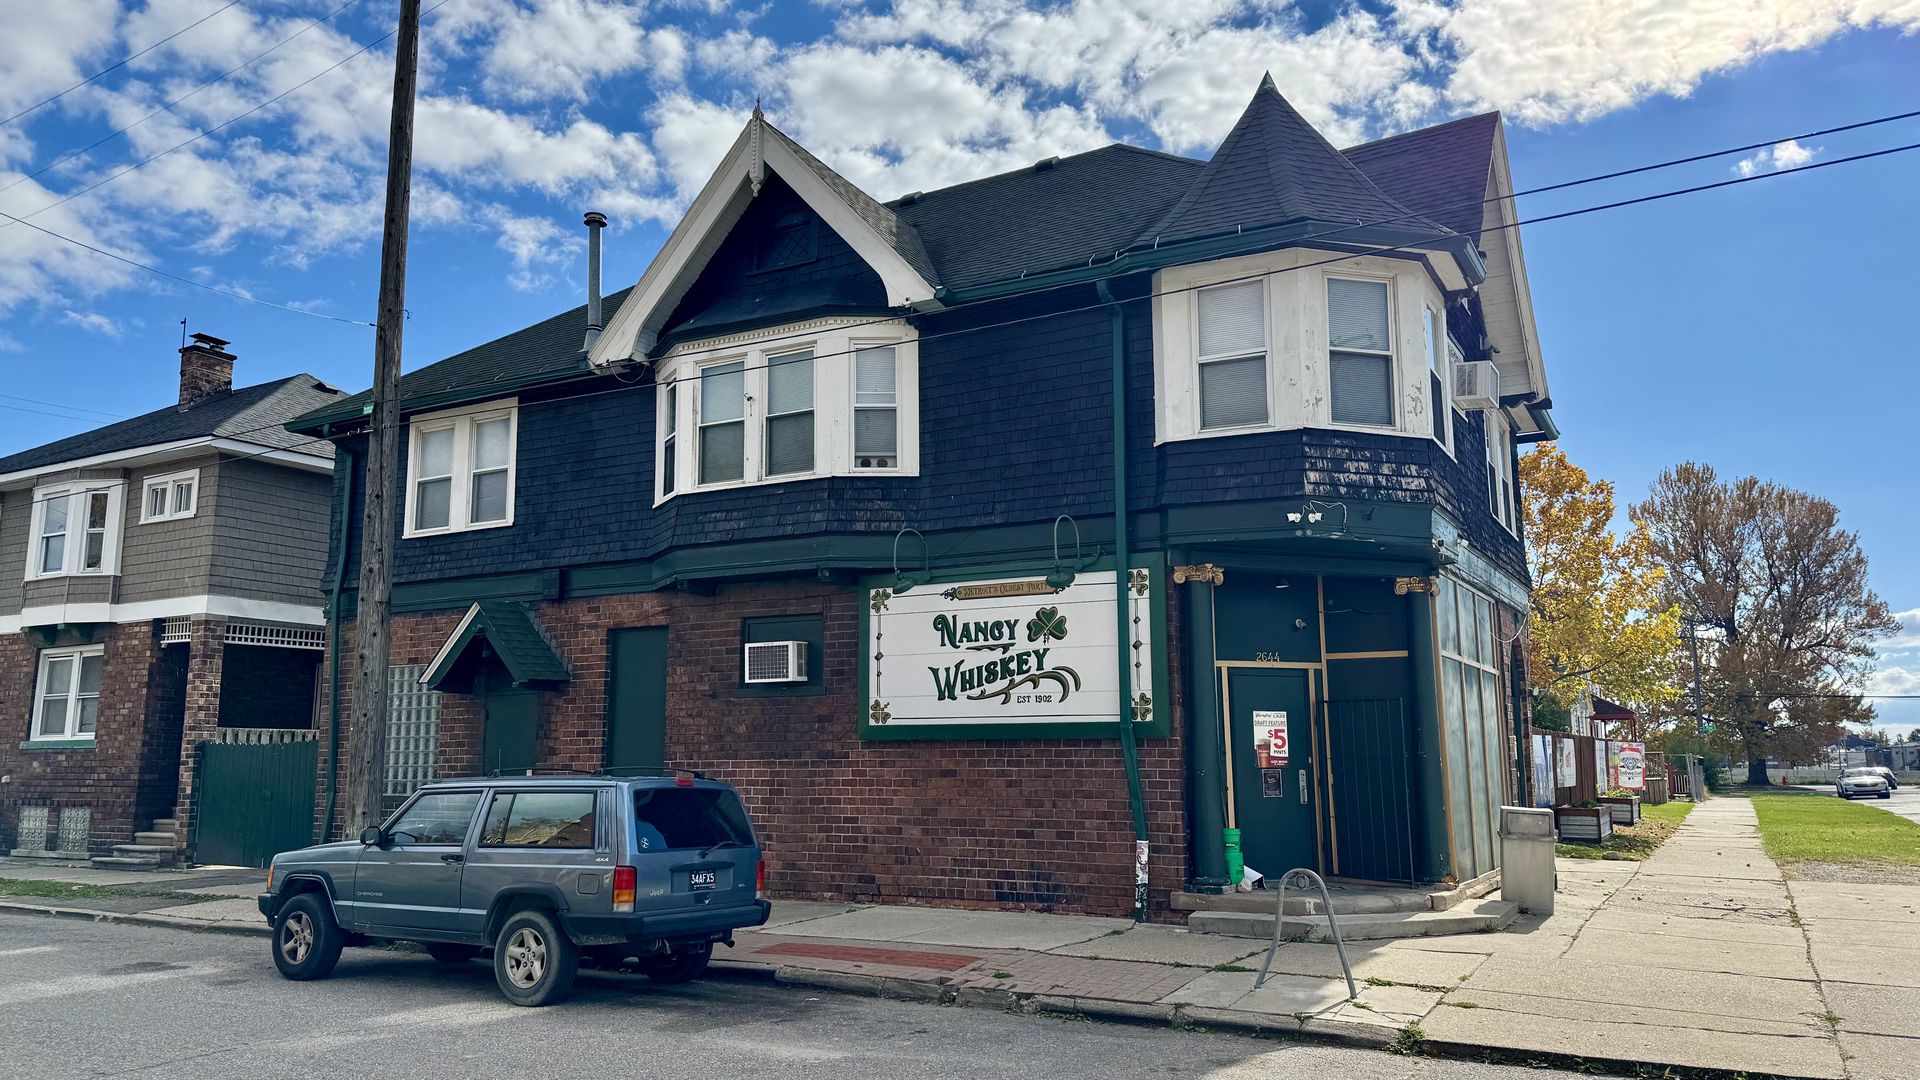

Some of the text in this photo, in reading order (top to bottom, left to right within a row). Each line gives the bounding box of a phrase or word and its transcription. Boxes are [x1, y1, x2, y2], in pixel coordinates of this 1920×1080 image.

[963, 585, 998, 597] DETROIT'S
[999, 583, 1024, 595] OLDEST
[932, 613, 1020, 649] NANCY
[1255, 651, 1281, 662] 2644
[927, 647, 1051, 702] WHISKEY
[1017, 695, 1052, 704] EST 1902
[1268, 728, 1286, 749] $5
[691, 872, 714, 884] 34AFX5
